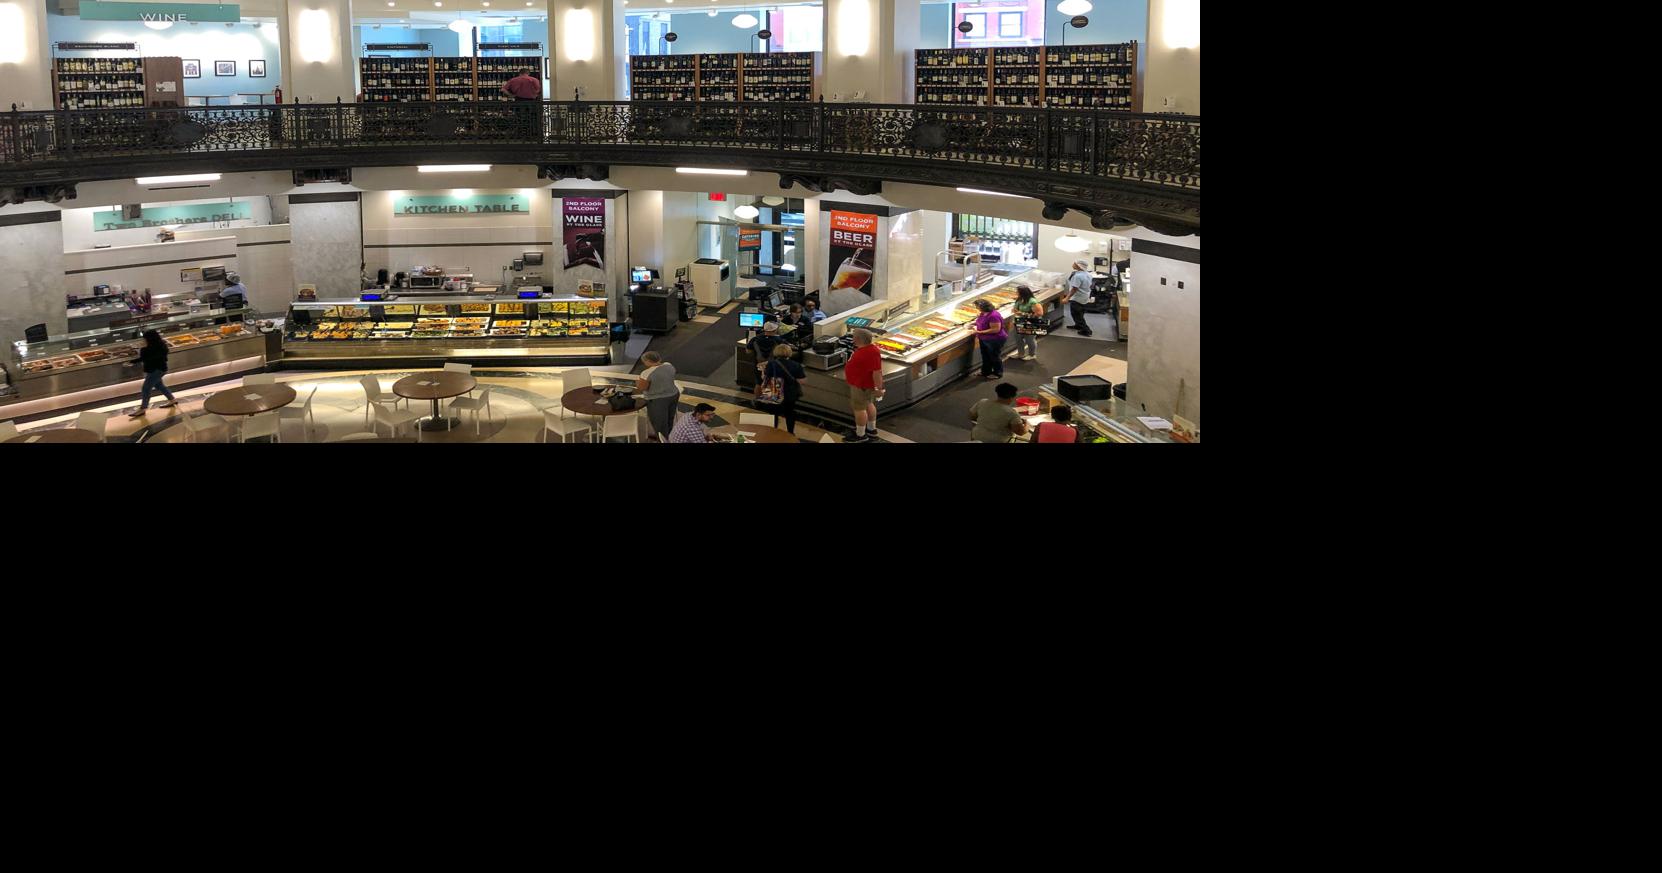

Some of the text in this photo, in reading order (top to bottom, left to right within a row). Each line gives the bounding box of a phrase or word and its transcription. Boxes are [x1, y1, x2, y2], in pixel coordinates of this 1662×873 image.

[139, 13, 188, 23] WINE
[404, 204, 520, 215] KITCHEN TABLE
[565, 214, 603, 223] WINE
[850, 217, 874, 225] FLOOR
[837, 221, 870, 229] BALCONY
[833, 230, 873, 244] BEER
